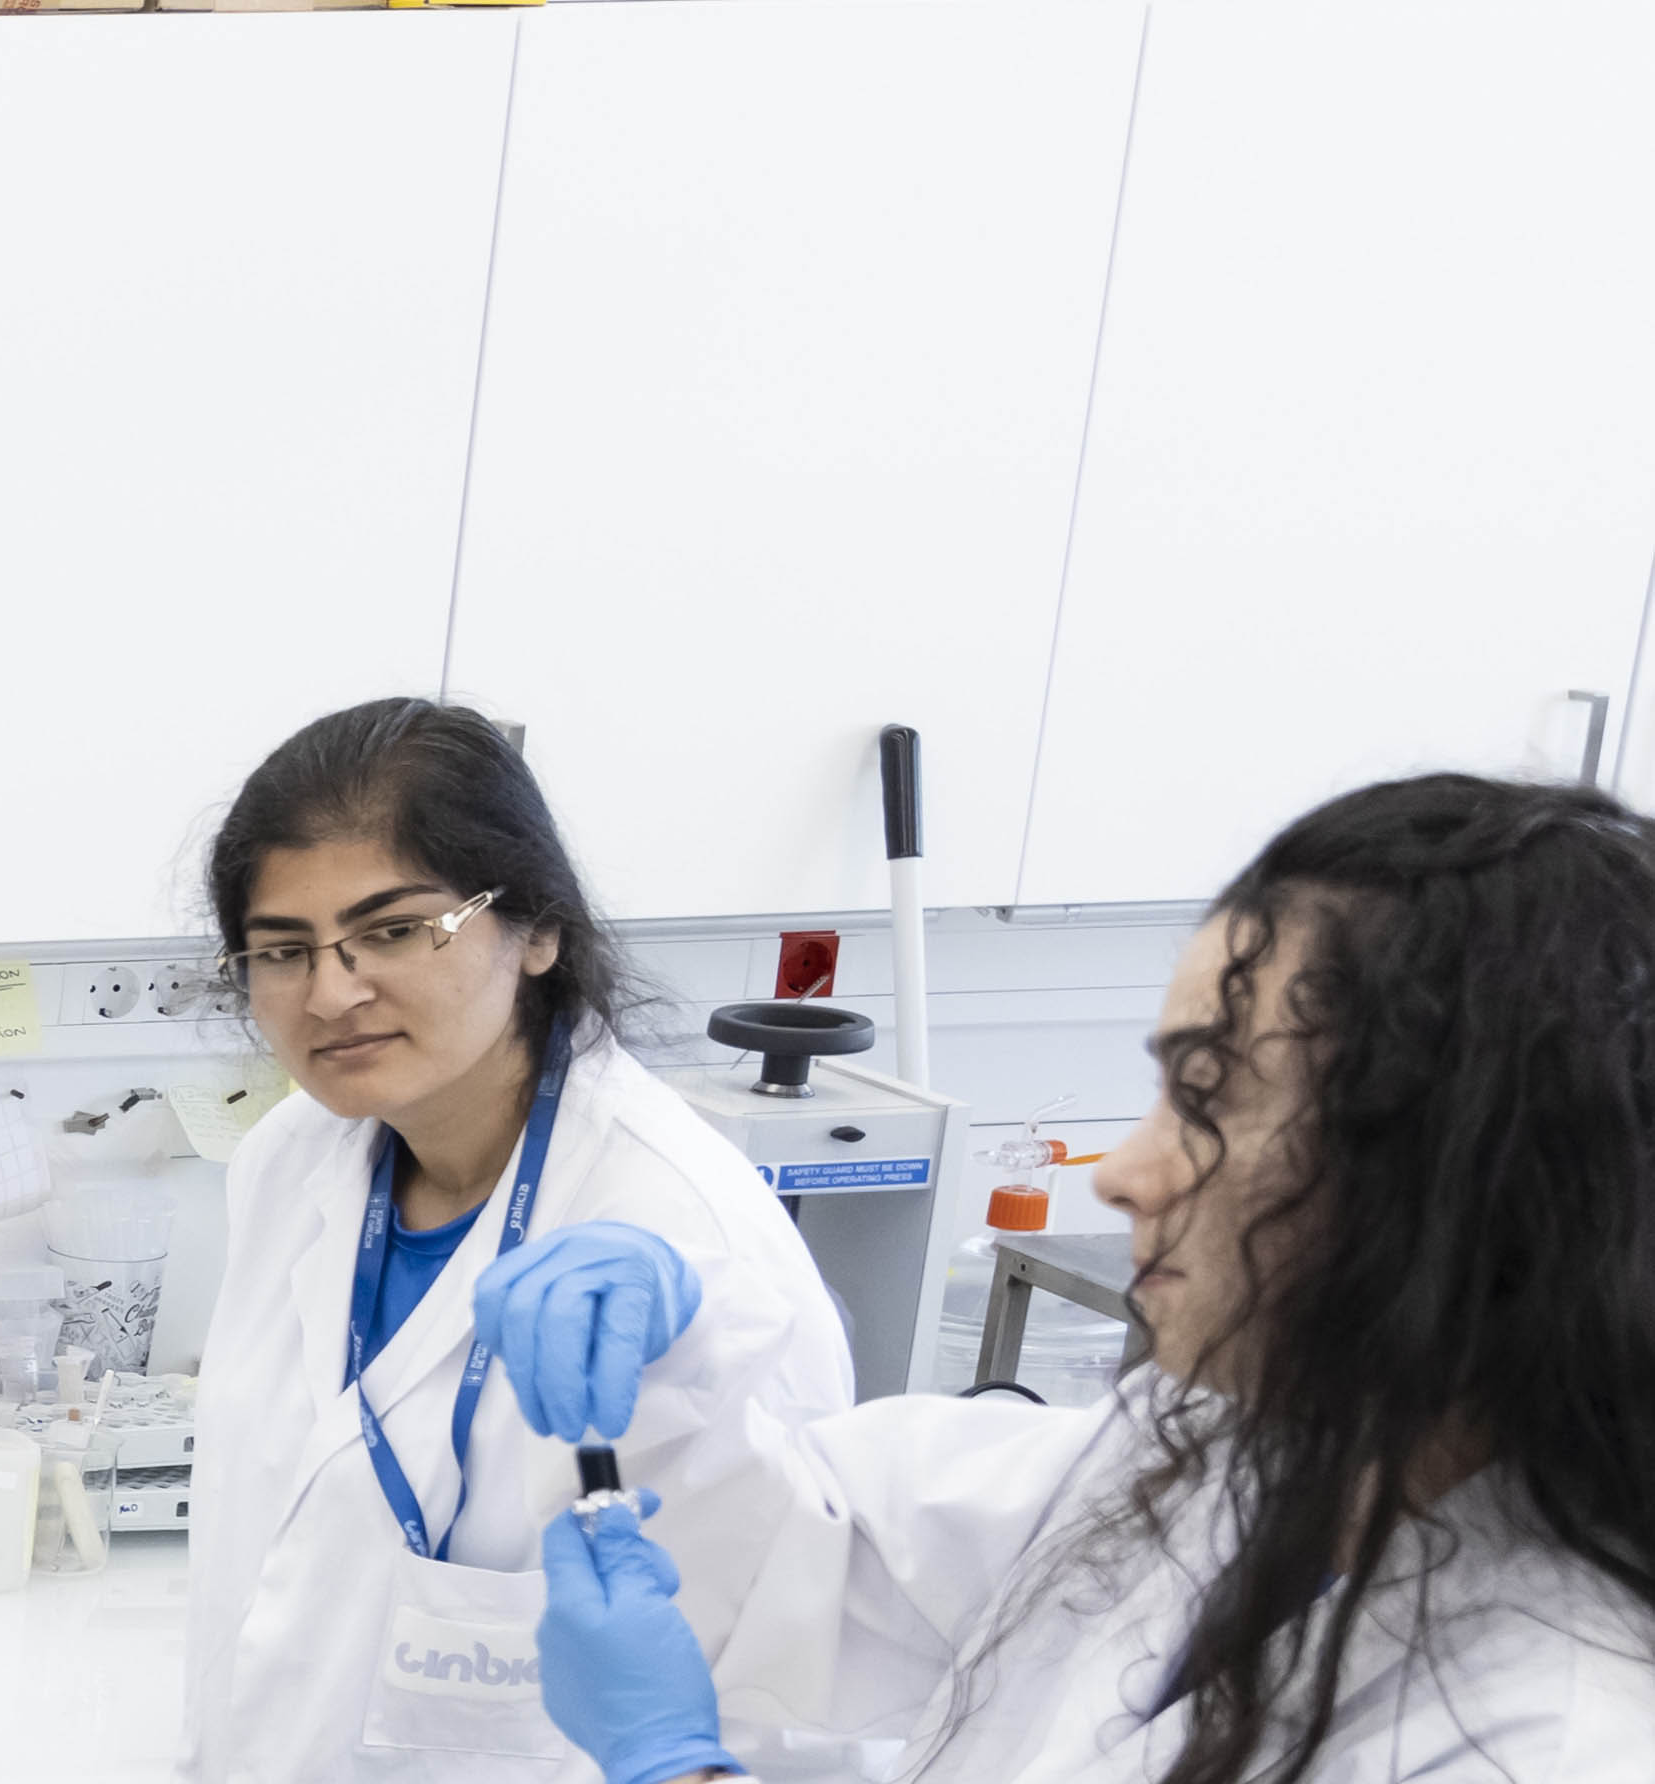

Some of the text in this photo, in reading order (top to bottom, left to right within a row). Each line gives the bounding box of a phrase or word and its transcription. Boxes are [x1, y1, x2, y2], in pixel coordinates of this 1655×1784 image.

[787, 1161, 924, 1177] SAFETY GUARD MUST BE DOWN
[794, 1172, 913, 1187] BEFORE OPERATING PRESS
[509, 1183, 531, 1242] galicia
